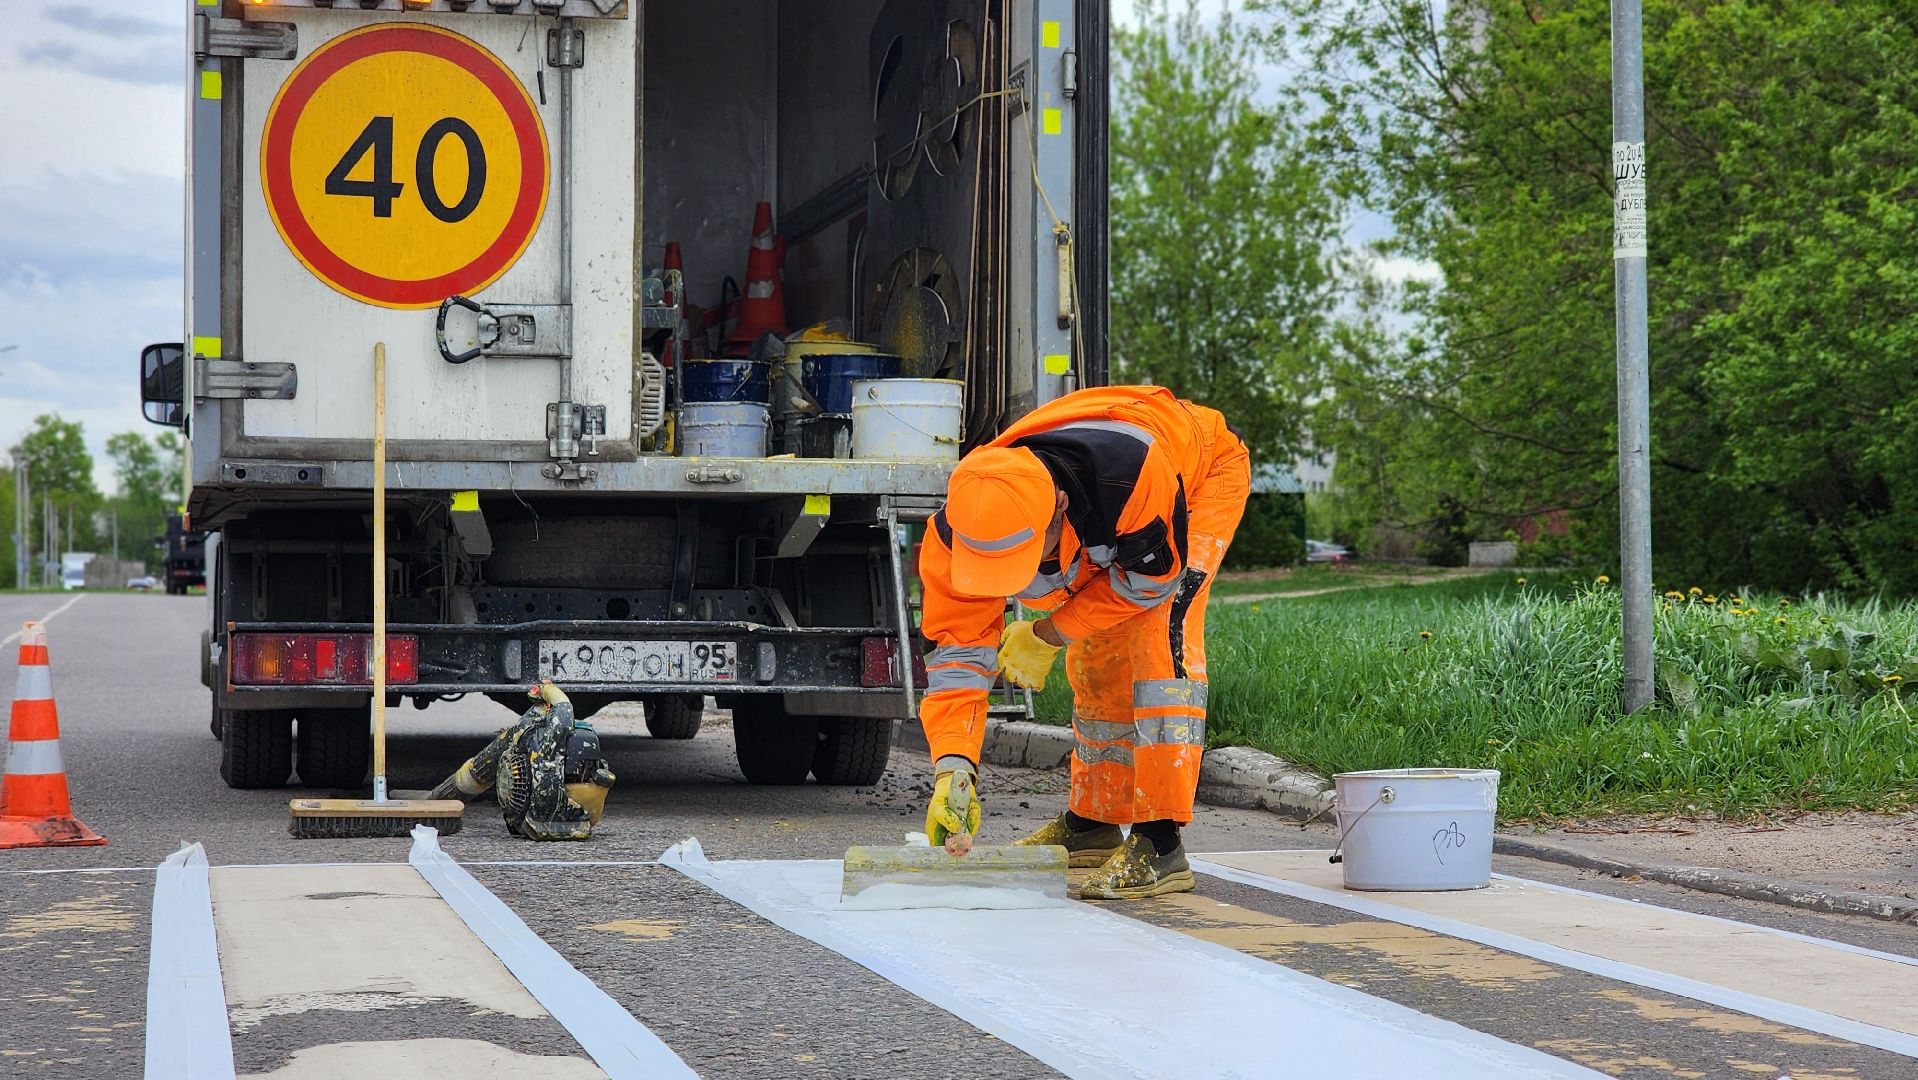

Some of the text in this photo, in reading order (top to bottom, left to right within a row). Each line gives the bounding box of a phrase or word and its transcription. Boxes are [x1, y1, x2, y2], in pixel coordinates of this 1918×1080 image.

[325, 116, 487, 223] 40
[693, 645, 726, 669] 95
[692, 668, 716, 679] RUS
